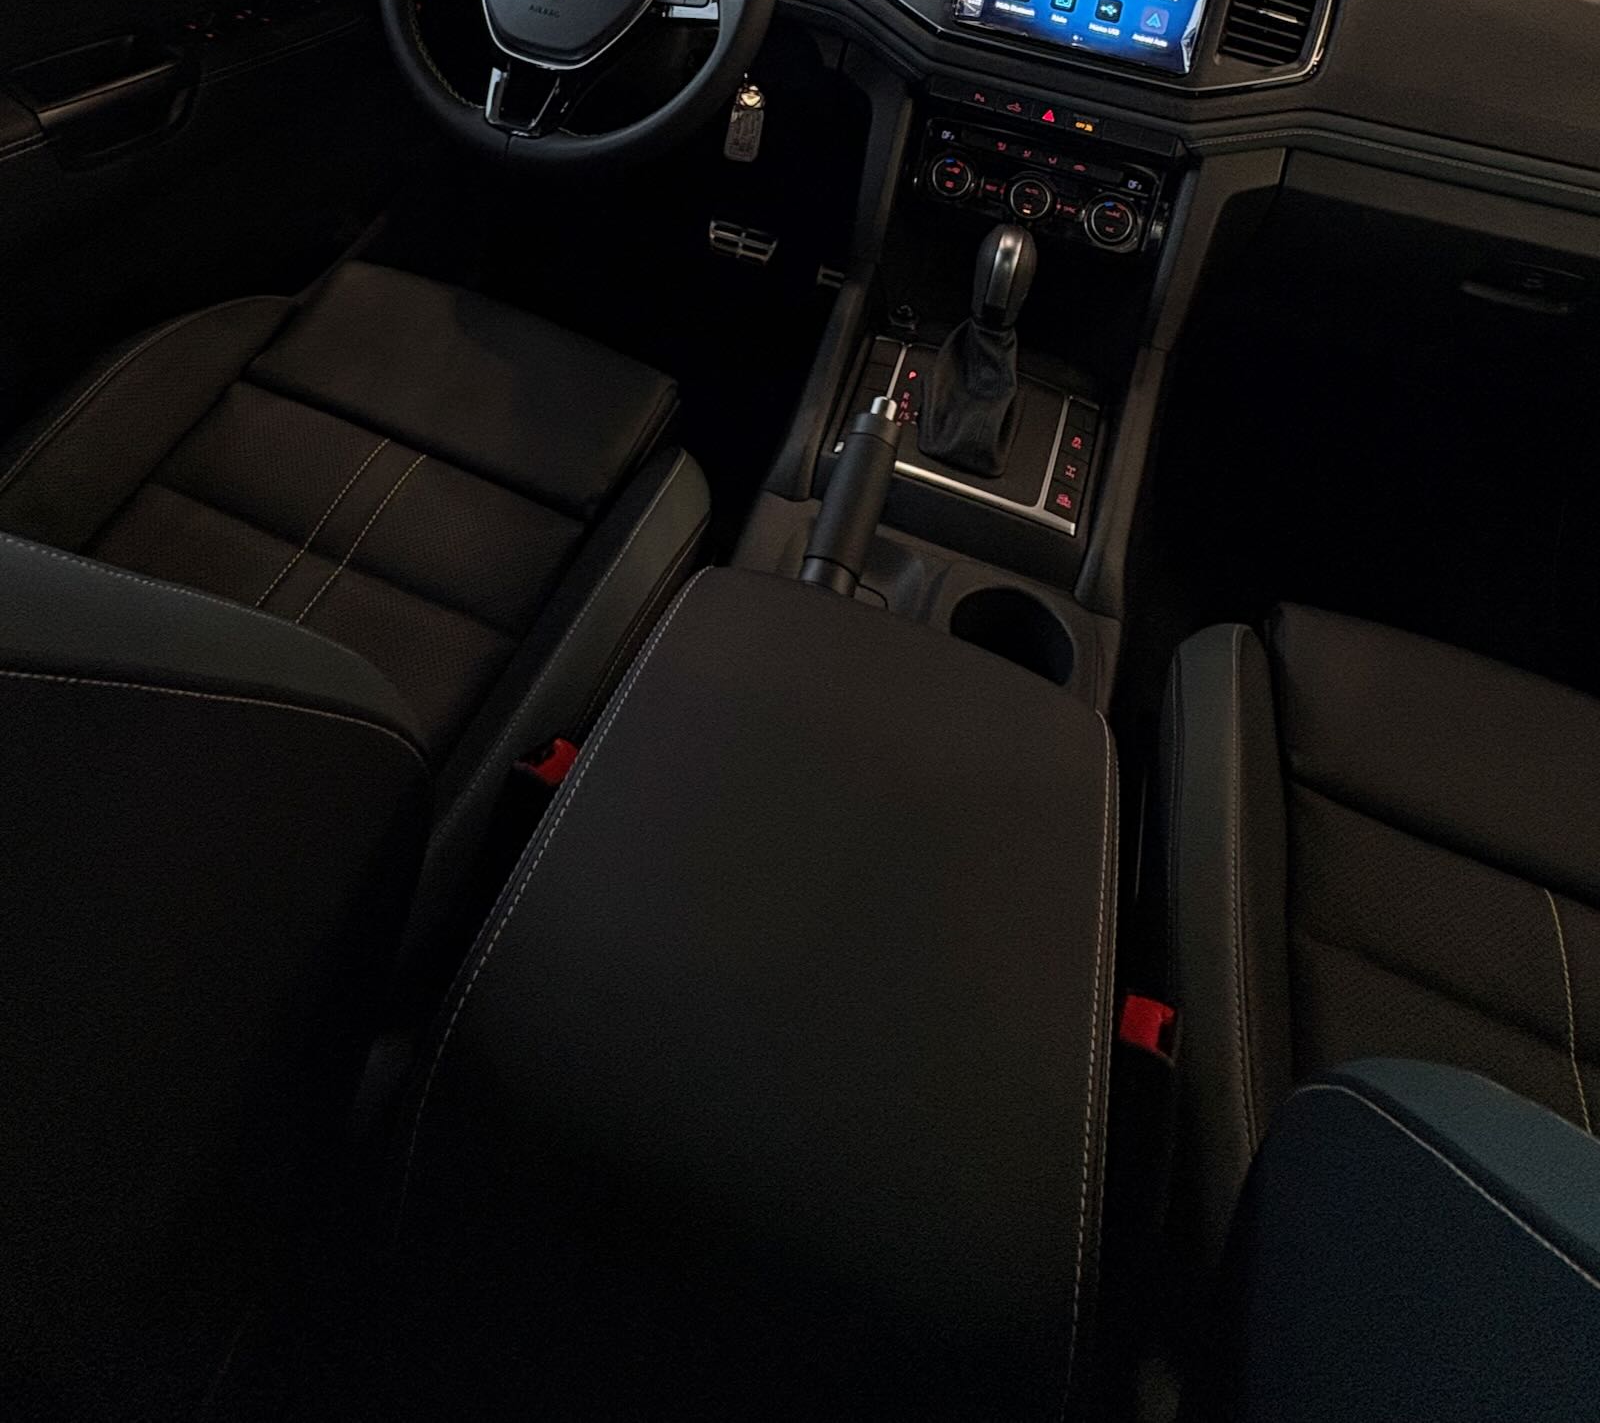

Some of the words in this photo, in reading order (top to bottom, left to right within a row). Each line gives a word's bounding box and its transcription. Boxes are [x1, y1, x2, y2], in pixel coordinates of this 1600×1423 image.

[909, 371, 917, 379] P
[903, 392, 910, 400] R
[900, 401, 908, 409] N
